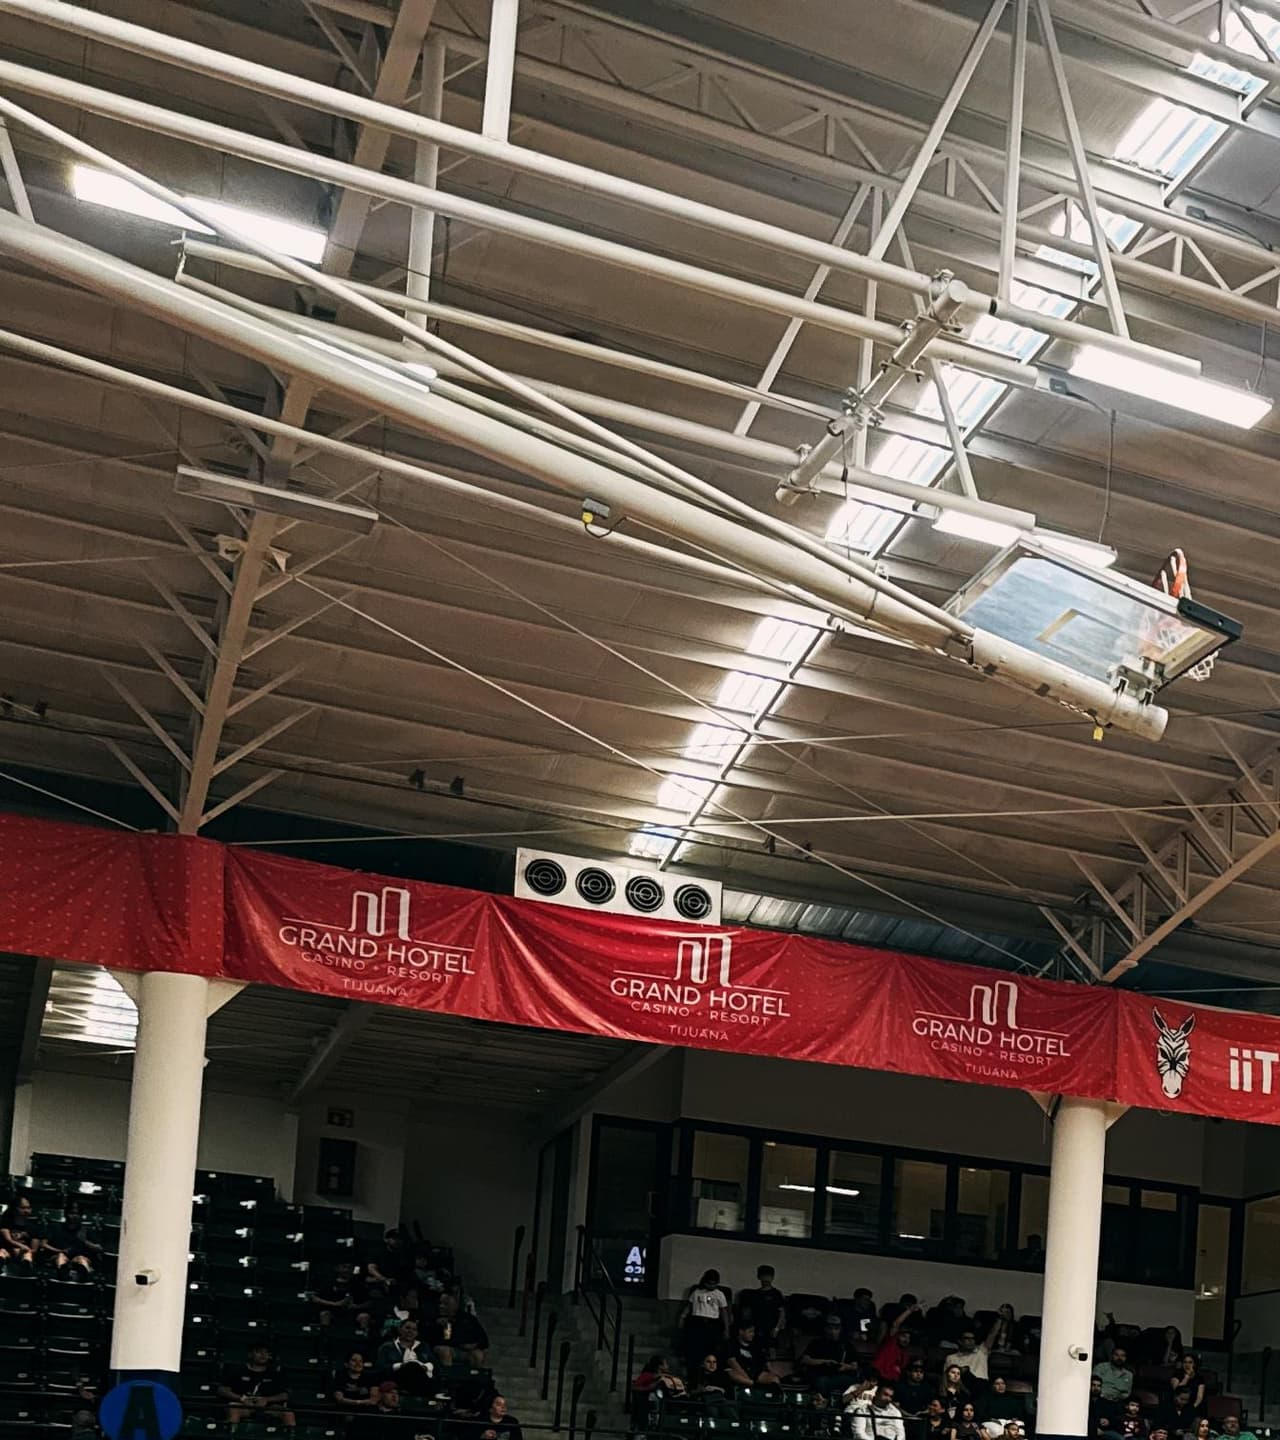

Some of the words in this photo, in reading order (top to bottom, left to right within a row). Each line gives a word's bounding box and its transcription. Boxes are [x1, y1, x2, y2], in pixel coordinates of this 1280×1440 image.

[279, 926, 378, 958] GRAND
[387, 943, 475, 975] HOTEL
[301, 953, 365, 971] CASINO
[387, 965, 452, 984] RESORT
[342, 978, 409, 998] TIJUANA
[610, 977, 700, 1005] GRAND
[709, 990, 791, 1017] HOTEL
[631, 1001, 690, 1017] CASINO
[709, 1010, 770, 1026] RESORT
[668, 1025, 729, 1041] TIJUANA
[912, 1018, 992, 1045] GRAND
[1000, 1031, 1071, 1057] HOTEL
[931, 1040, 983, 1057] CASINO
[1000, 1051, 1053, 1067] RESORT
[965, 1063, 1019, 1080] TIJUANA
